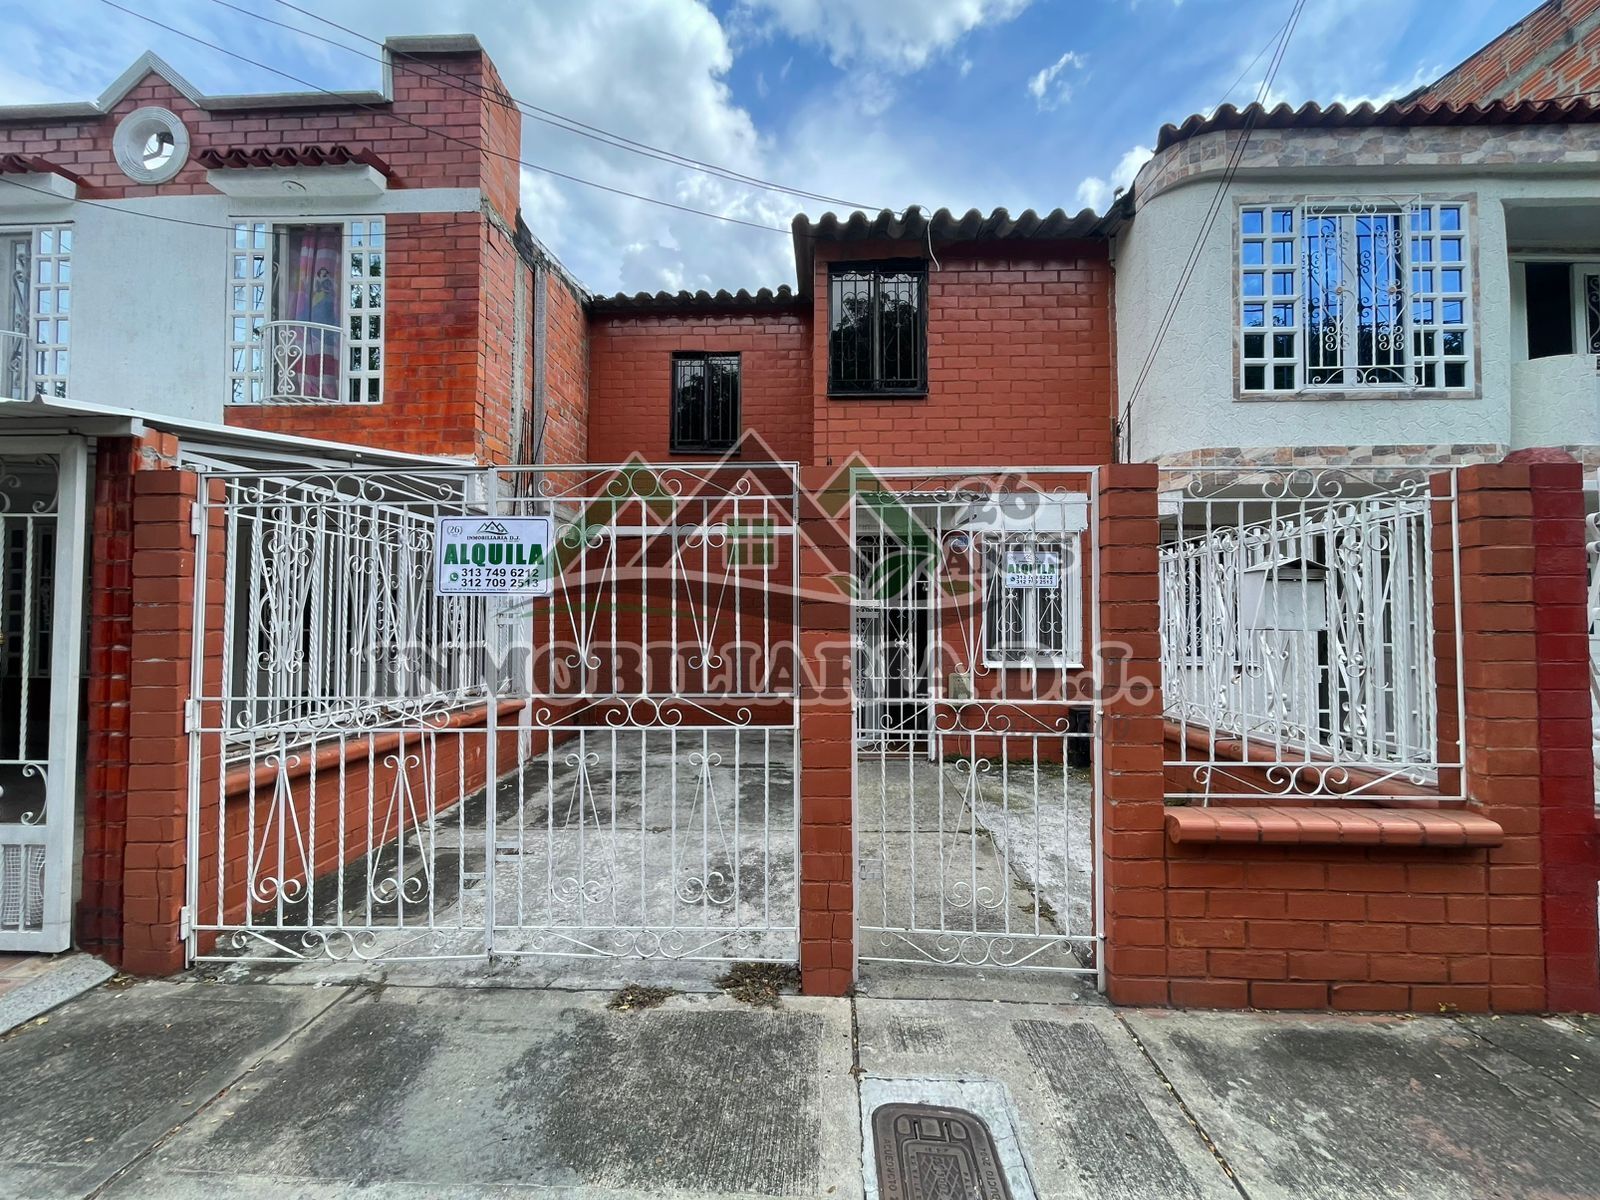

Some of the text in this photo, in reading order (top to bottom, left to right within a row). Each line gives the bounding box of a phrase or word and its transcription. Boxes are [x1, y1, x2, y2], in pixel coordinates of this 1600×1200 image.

[444, 543, 544, 567] ALQUILA
[461, 568, 539, 577] 313 749 6212
[461, 579, 539, 587] 312 709 2513
